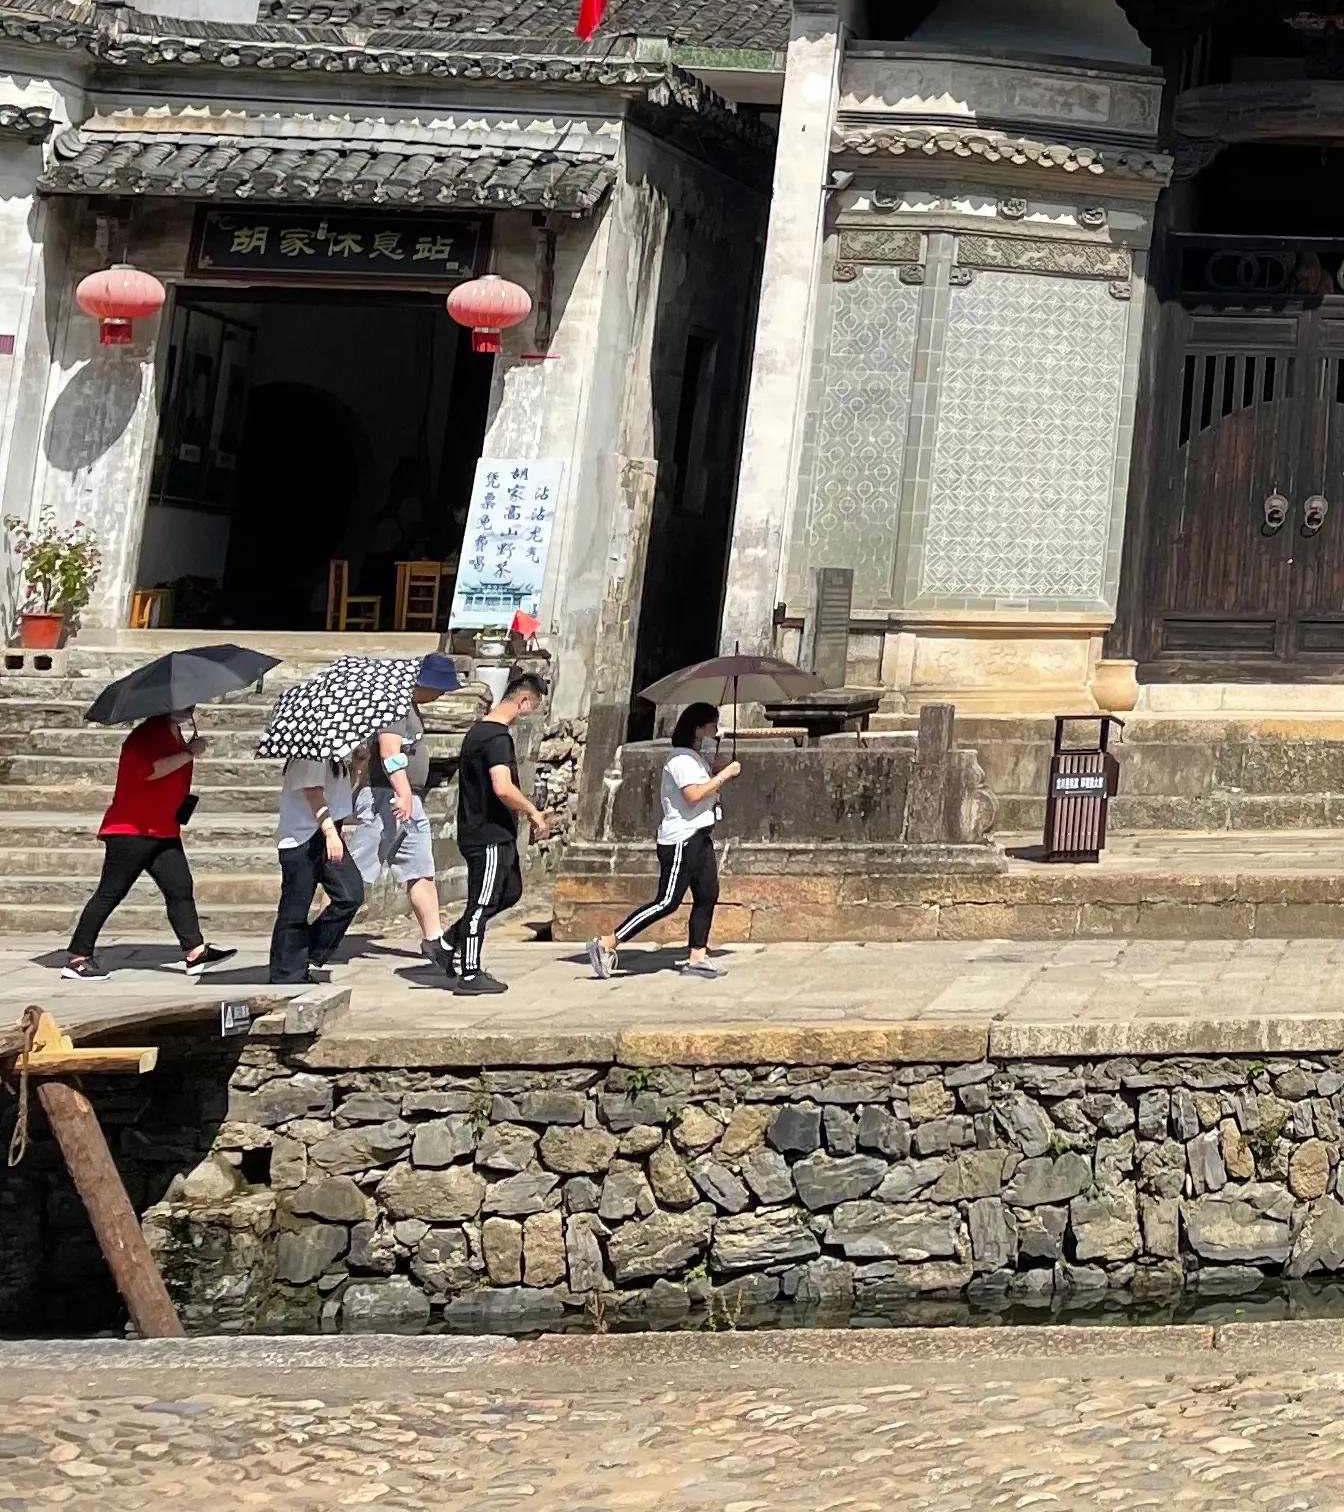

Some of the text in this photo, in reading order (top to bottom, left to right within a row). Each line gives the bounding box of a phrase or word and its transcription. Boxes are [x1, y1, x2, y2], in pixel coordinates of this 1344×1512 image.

[229, 226, 455, 261] 胡家休息站
